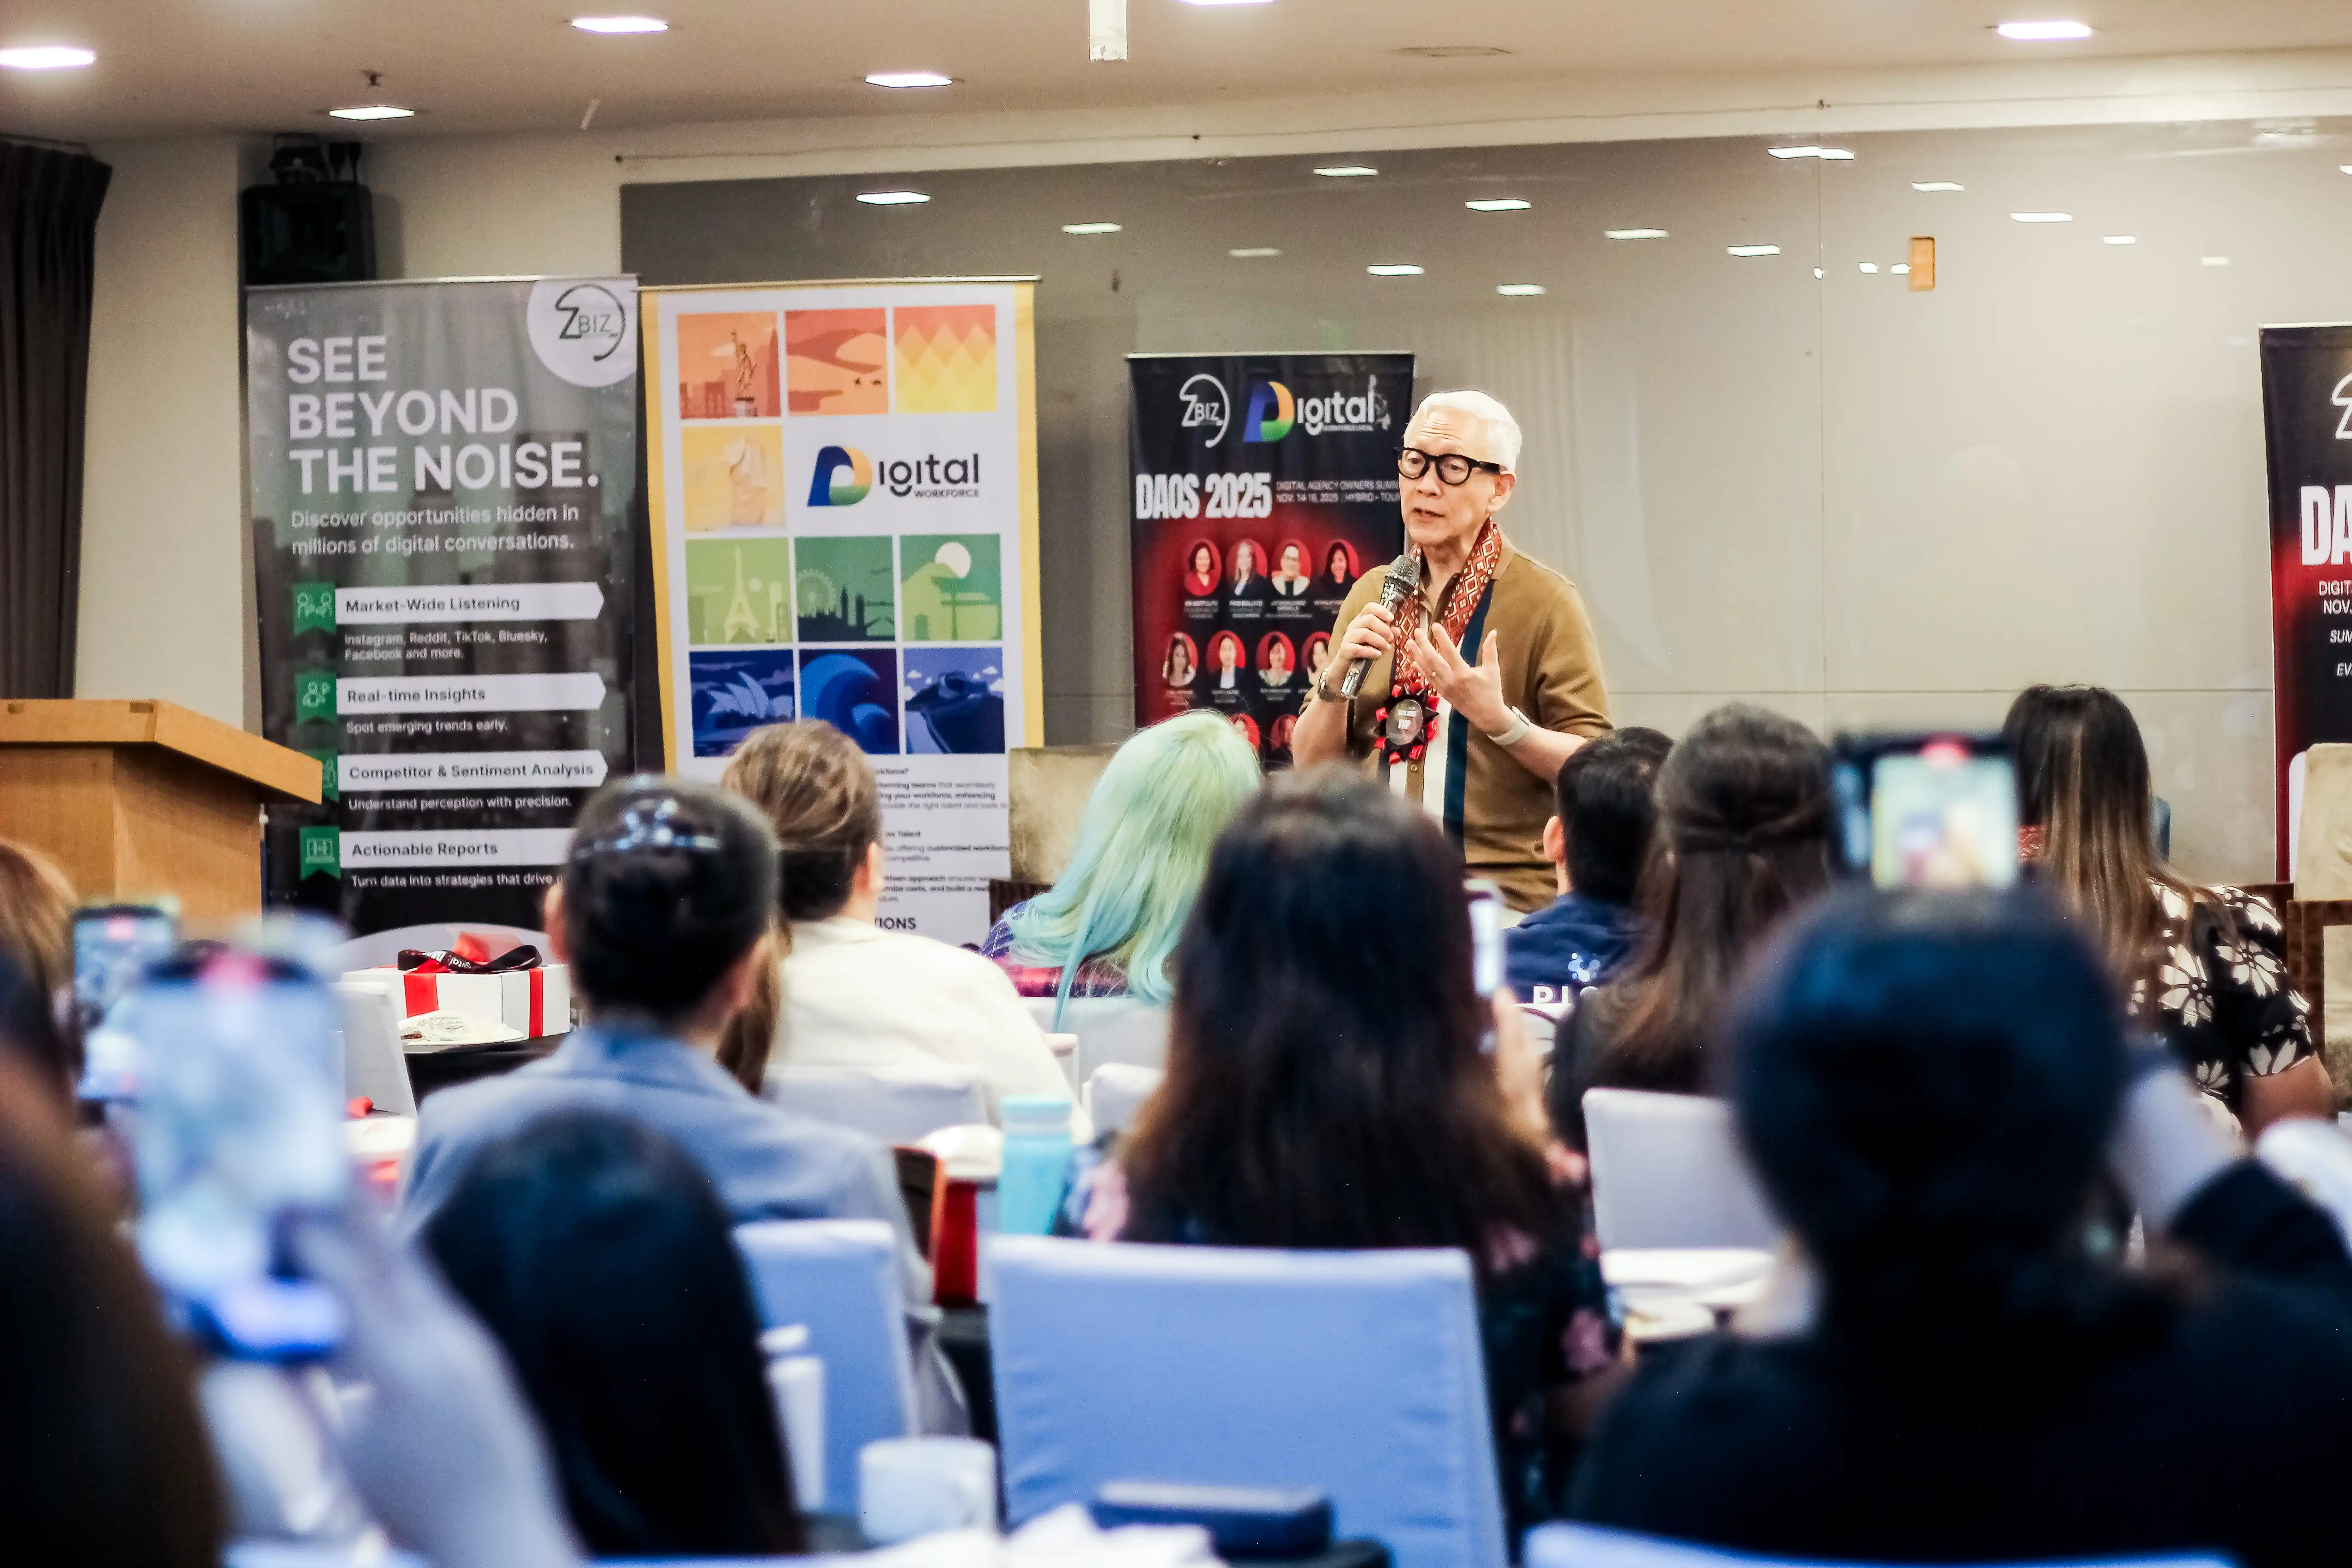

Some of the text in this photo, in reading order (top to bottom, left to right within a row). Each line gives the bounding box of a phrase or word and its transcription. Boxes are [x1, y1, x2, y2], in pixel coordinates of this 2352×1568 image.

[288, 336, 387, 383] SEE
[289, 388, 518, 439] BEYOND
[1243, 381, 1374, 442] Digital
[289, 441, 598, 495] THE NOISE.
[807, 445, 979, 507] Digital
[915, 489, 979, 498] WORKFORCE
[1136, 472, 1272, 519] DAOS 2025
[292, 505, 579, 529] Discover opportunities hidden in
[2301, 485, 2352, 566] DA
[293, 534, 573, 557] millions of digital conversations.
[2319, 580, 2352, 595] DIGIT
[346, 597, 520, 612] Market-Wide Listening
[2324, 599, 2352, 614] NOV.
[346, 633, 406, 647] Instagram,
[410, 632, 451, 644] Reddit,
[456, 632, 495, 643] TikTok,
[346, 648, 463, 661] Facebook and more.
[348, 688, 485, 703] Real-time Insights
[347, 719, 507, 735] Spot emerging trends early.
[350, 764, 593, 781] Competitor & Sentiment Analysis
[349, 796, 571, 811] Understand perception with precision.
[352, 842, 497, 858] Actionable Reports
[352, 876, 376, 887] Turn
[381, 875, 406, 887] data
[410, 875, 431, 886] into
[436, 874, 493, 887] strategies
[497, 873, 519, 885] that
[524, 873, 552, 884] drive
